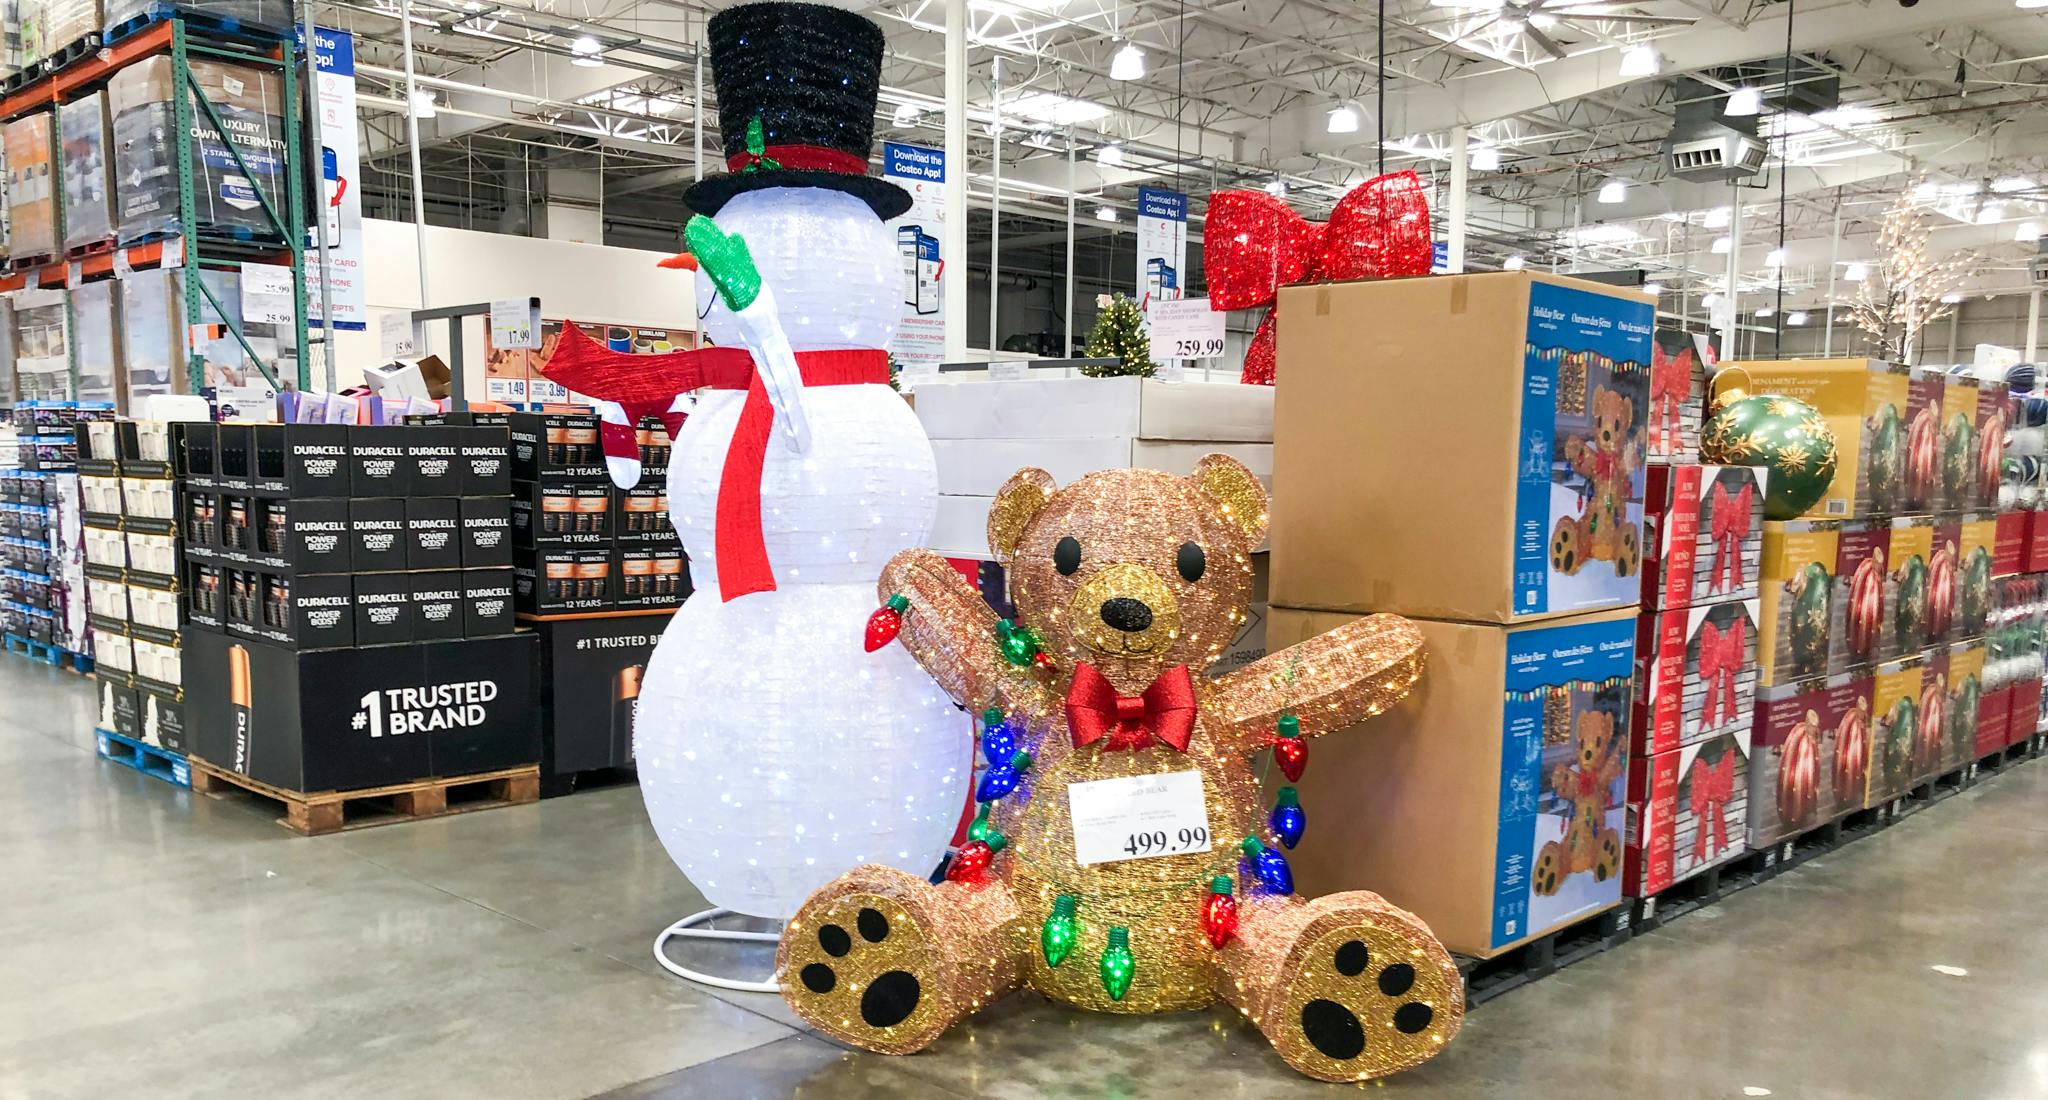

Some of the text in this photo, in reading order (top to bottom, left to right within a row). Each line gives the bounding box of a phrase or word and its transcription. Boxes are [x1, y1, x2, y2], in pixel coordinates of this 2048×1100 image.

[314, 36, 334, 49] the
[223, 119, 260, 132] UXURY
[190, 128, 287, 149] OWN LTERNATIV
[894, 149, 942, 166] Download the
[896, 162, 941, 179] Costco App!
[1146, 193, 1171, 204] Download
[1146, 204, 1166, 214] Costco
[335, 259, 357, 268] CARD
[330, 279, 352, 287] HONE
[266, 314, 290, 322] 25.99
[508, 330, 529, 344] 17.99
[395, 341, 412, 354] 15.99
[1176, 339, 1224, 356] 259.99
[508, 382, 524, 395] 1.49
[549, 384, 566, 396] 3.99
[512, 432, 536, 442] DURACELL
[294, 446, 346, 455] DURACELL
[353, 447, 403, 456] DURACELL
[409, 447, 456, 456] DURACELL
[462, 447, 507, 456] DURACELL
[304, 460, 337, 468] POWER
[418, 460, 448, 468] POWER
[566, 468, 574, 476] 12
[576, 468, 602, 476] YEARS
[295, 522, 346, 531] DURACELL
[354, 521, 402, 530] DURACELL
[409, 520, 456, 528] DURACELL
[464, 518, 508, 527] DURACELL
[305, 536, 338, 544] POWER
[363, 534, 394, 542] POWER
[573, 534, 600, 542] YEARS
[650, 532, 674, 540] YEARS
[421, 540, 445, 548] BOOST
[476, 538, 498, 546] BOOST
[413, 591, 460, 601] DURACELL
[466, 588, 511, 598] DURACELL
[298, 597, 350, 607] DURACELL
[358, 594, 407, 604] DURACELL
[566, 599, 602, 608] 12 YEARS
[651, 596, 676, 604] YEARS
[422, 604, 452, 612] POWER
[476, 600, 504, 608] POWER
[308, 610, 340, 619] POWER
[368, 607, 399, 615] POWER
[478, 608, 501, 616] BOOST
[311, 618, 337, 626] BOOST
[371, 614, 396, 622] BOOST
[576, 639, 592, 650] #1
[594, 636, 647, 648] TRUSTED
[351, 680, 498, 738] #1 TRUSTED
[389, 704, 486, 736] BRAND
[1124, 826, 1207, 856] 499.99
